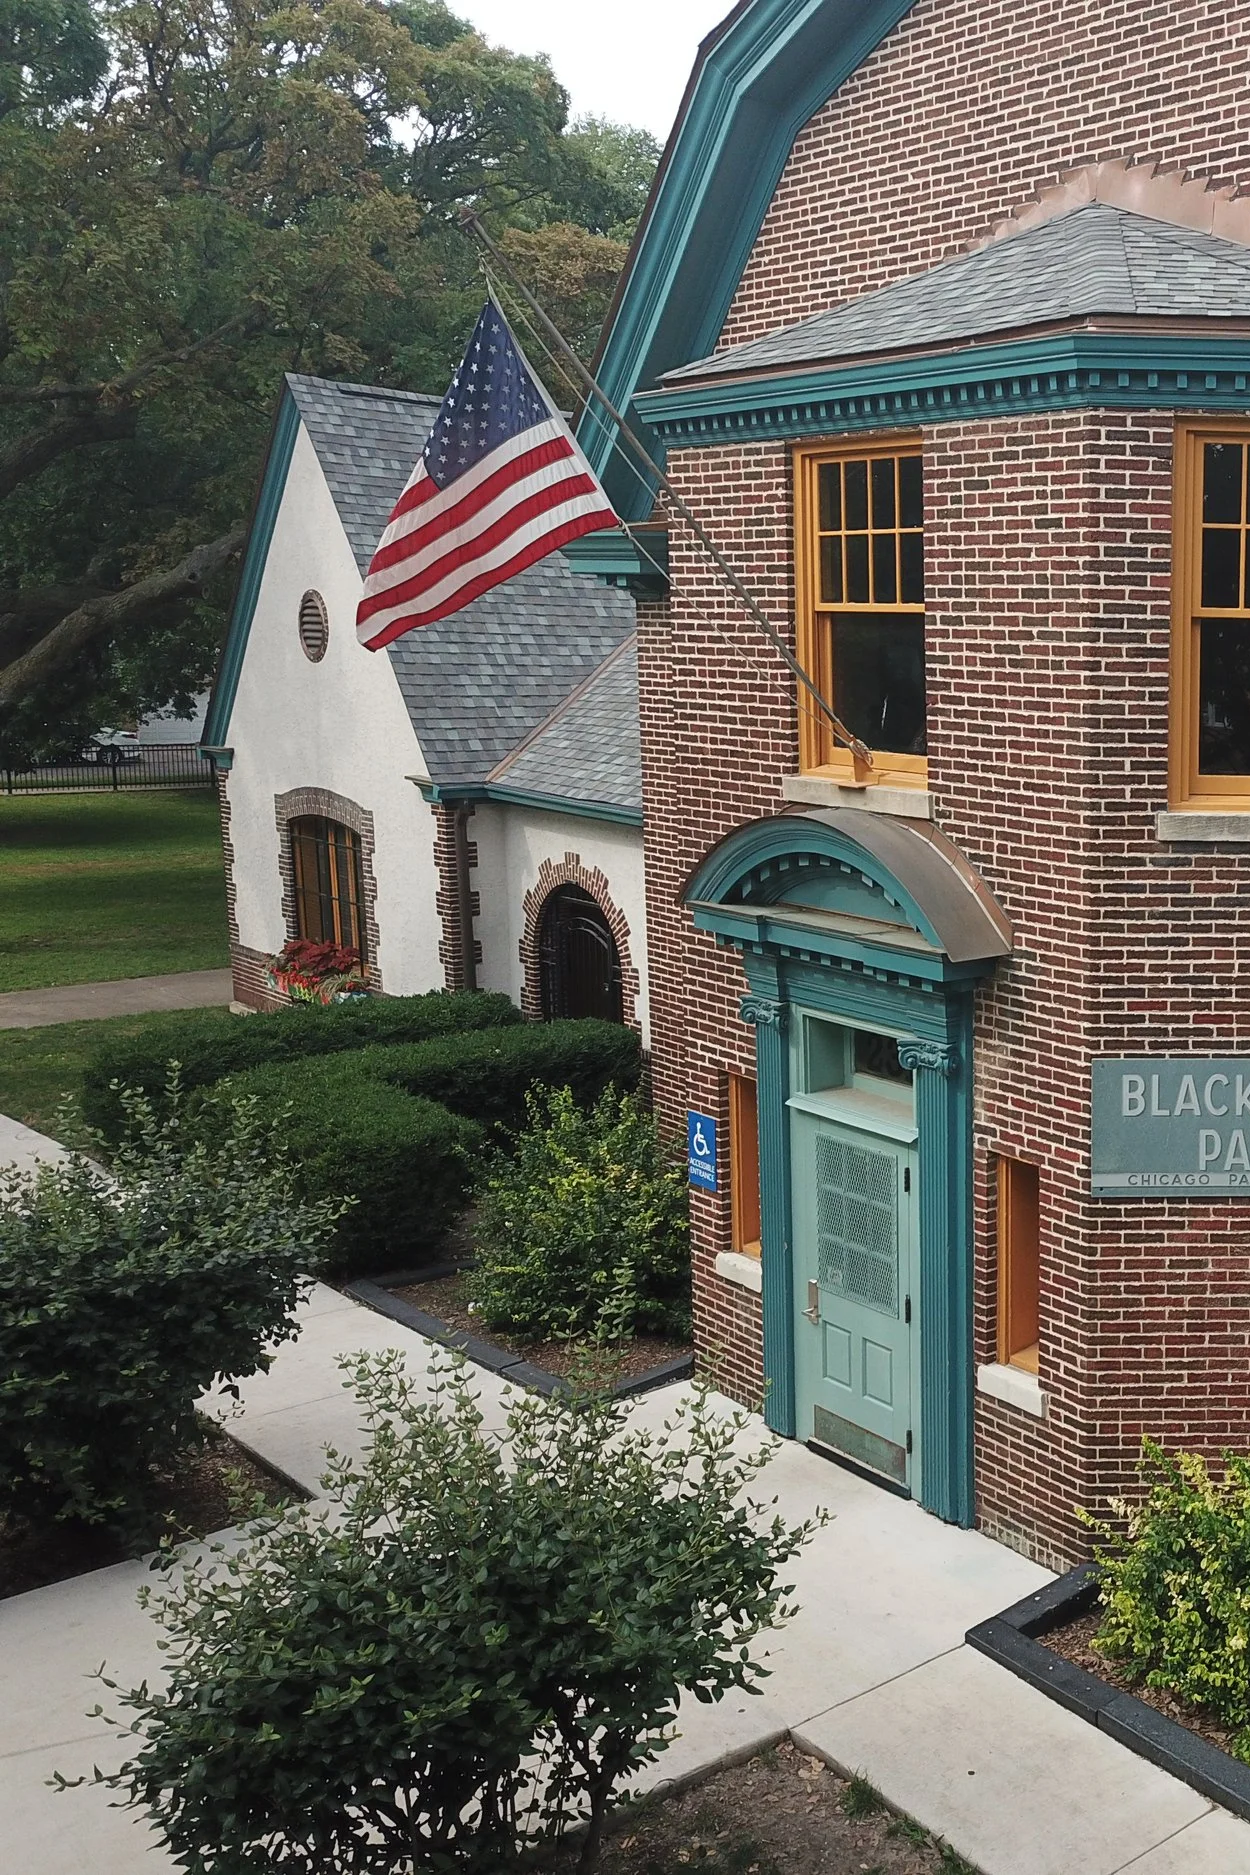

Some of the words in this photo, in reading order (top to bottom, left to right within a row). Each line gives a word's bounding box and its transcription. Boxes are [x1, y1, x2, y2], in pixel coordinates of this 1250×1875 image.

[689, 1157, 715, 1174] ACCESSIBLE
[689, 1165, 715, 1182] ENTRANCE
[1127, 1173, 1211, 1186] CHICAGO
